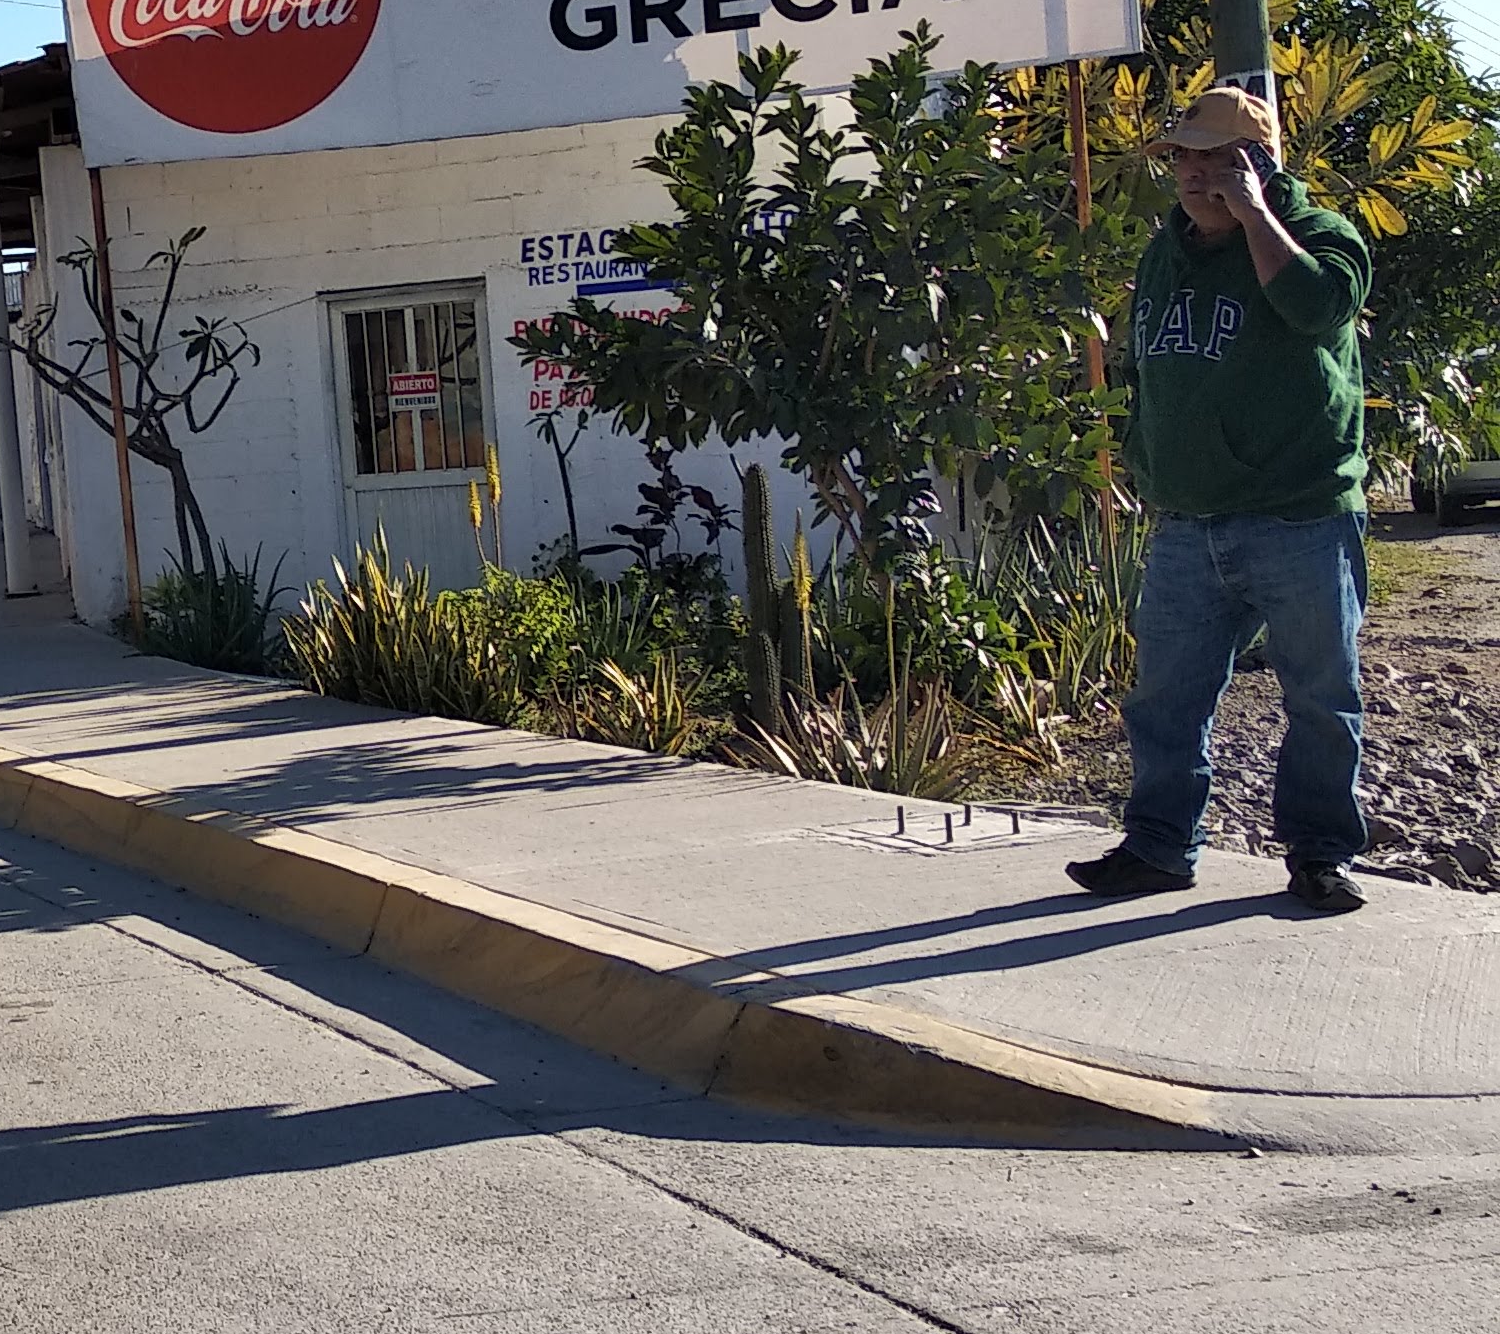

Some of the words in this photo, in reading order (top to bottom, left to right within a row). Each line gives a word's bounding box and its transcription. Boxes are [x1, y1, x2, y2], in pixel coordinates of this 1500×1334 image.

[528, 259, 649, 287] RESTAURAN
[392, 377, 435, 393] ABIERTO
[529, 389, 553, 411] DE
